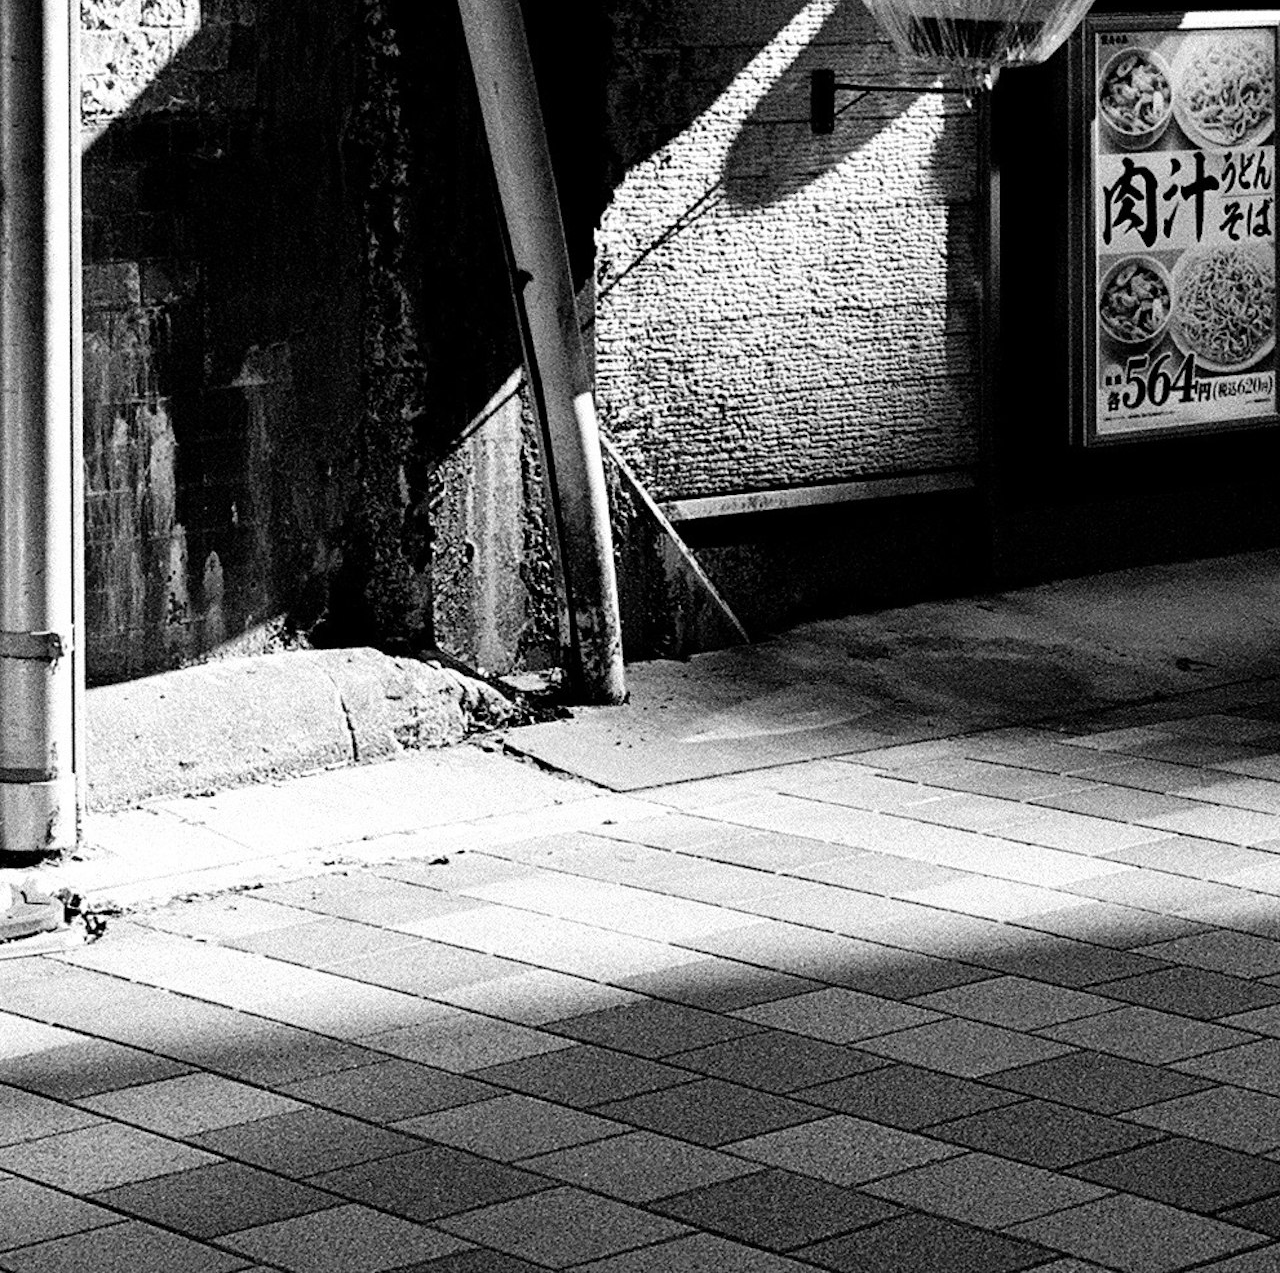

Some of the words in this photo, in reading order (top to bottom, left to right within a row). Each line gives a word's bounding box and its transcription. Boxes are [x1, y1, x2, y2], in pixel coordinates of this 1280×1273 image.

[1221, 150, 1272, 194] うどん
[1103, 151, 1220, 248] 肉汁
[1220, 197, 1274, 241] そば
